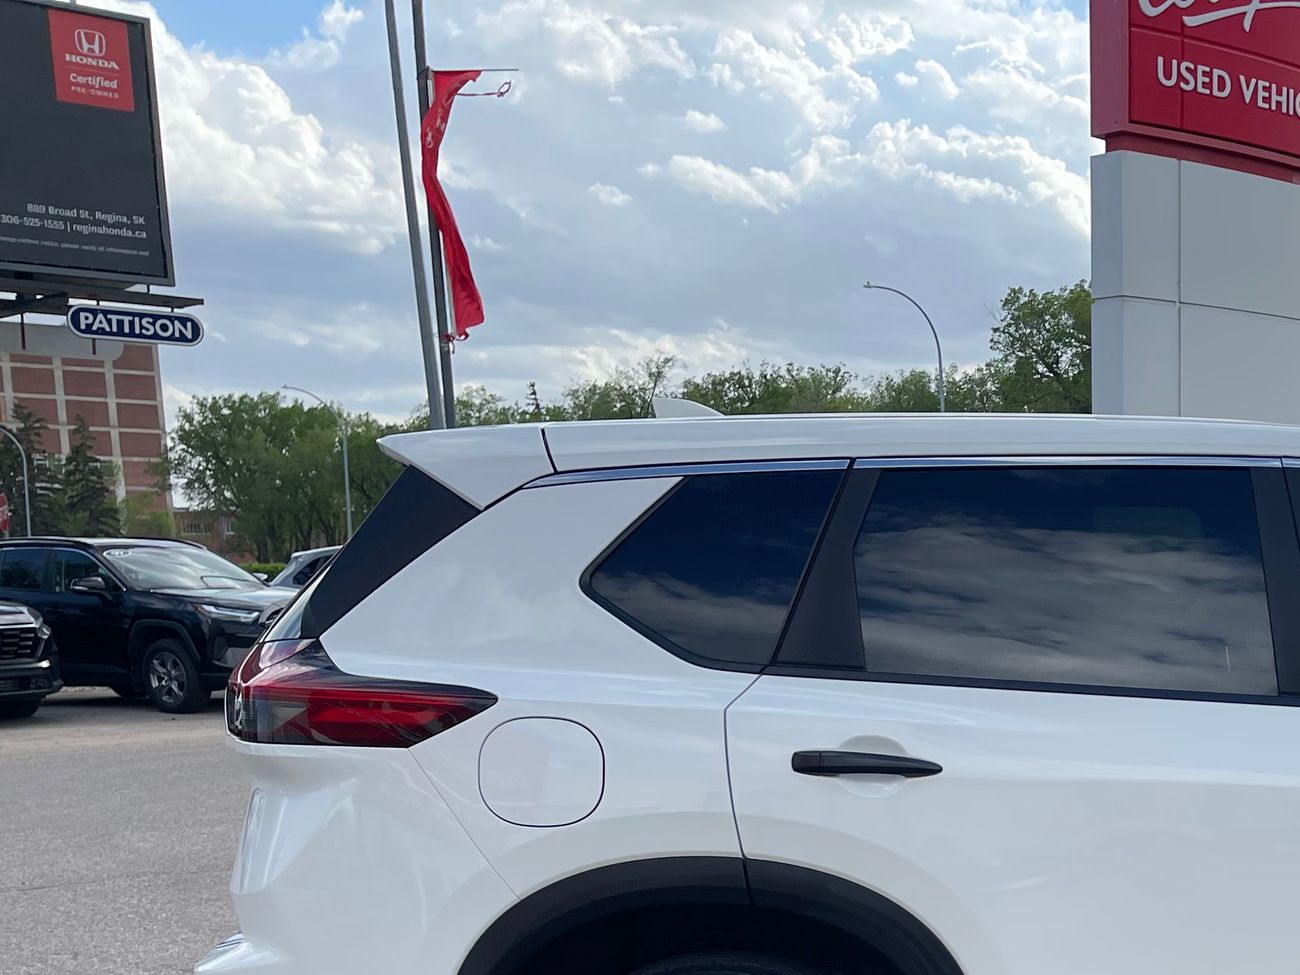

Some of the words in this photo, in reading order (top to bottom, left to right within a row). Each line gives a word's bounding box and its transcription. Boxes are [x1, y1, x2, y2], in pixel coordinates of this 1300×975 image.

[64, 53, 120, 70] HONDA
[70, 73, 118, 88] Certified
[1157, 56, 1232, 98] USED
[27, 203, 46, 214] 889
[48, 205, 77, 217] Broad
[79, 209, 93, 220] St.
[95, 211, 131, 224] Regina,
[132, 215, 145, 225] SK
[0, 214, 65, 230] 306-525-1555
[73, 223, 147, 239] reginahonda.ca
[80, 312, 192, 339] PATTISON
